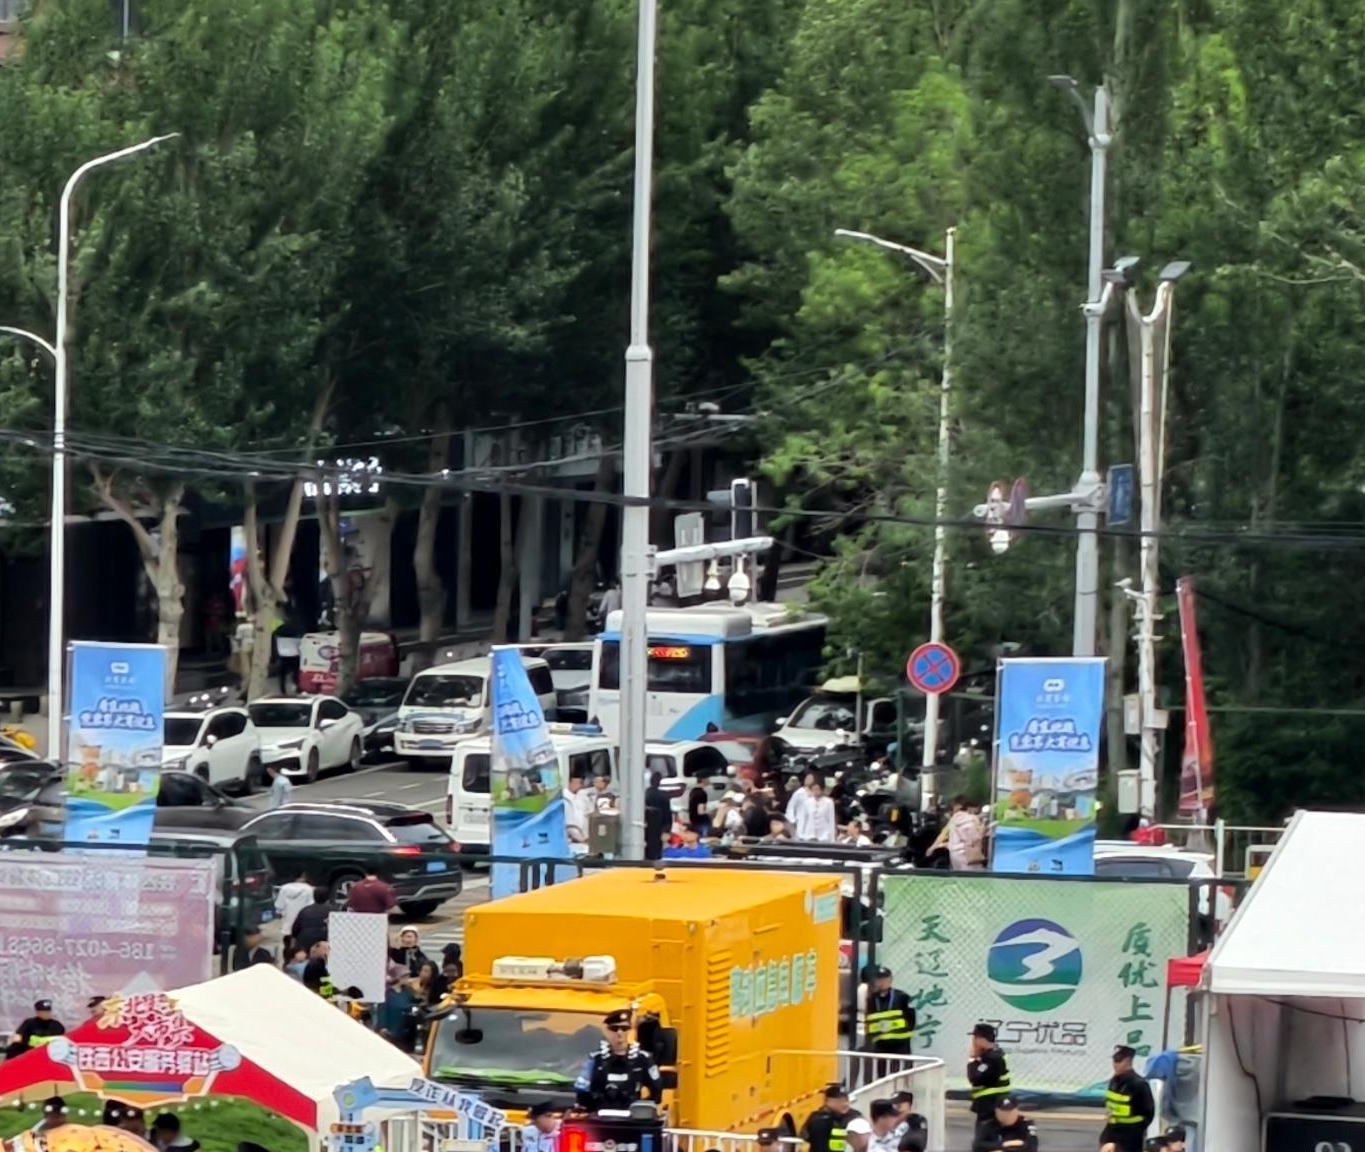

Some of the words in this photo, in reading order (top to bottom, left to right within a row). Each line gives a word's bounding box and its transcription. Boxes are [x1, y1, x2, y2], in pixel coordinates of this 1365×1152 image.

[910, 914, 951, 1049] 天辽地宁
[1117, 921, 1159, 1057] 质优上品
